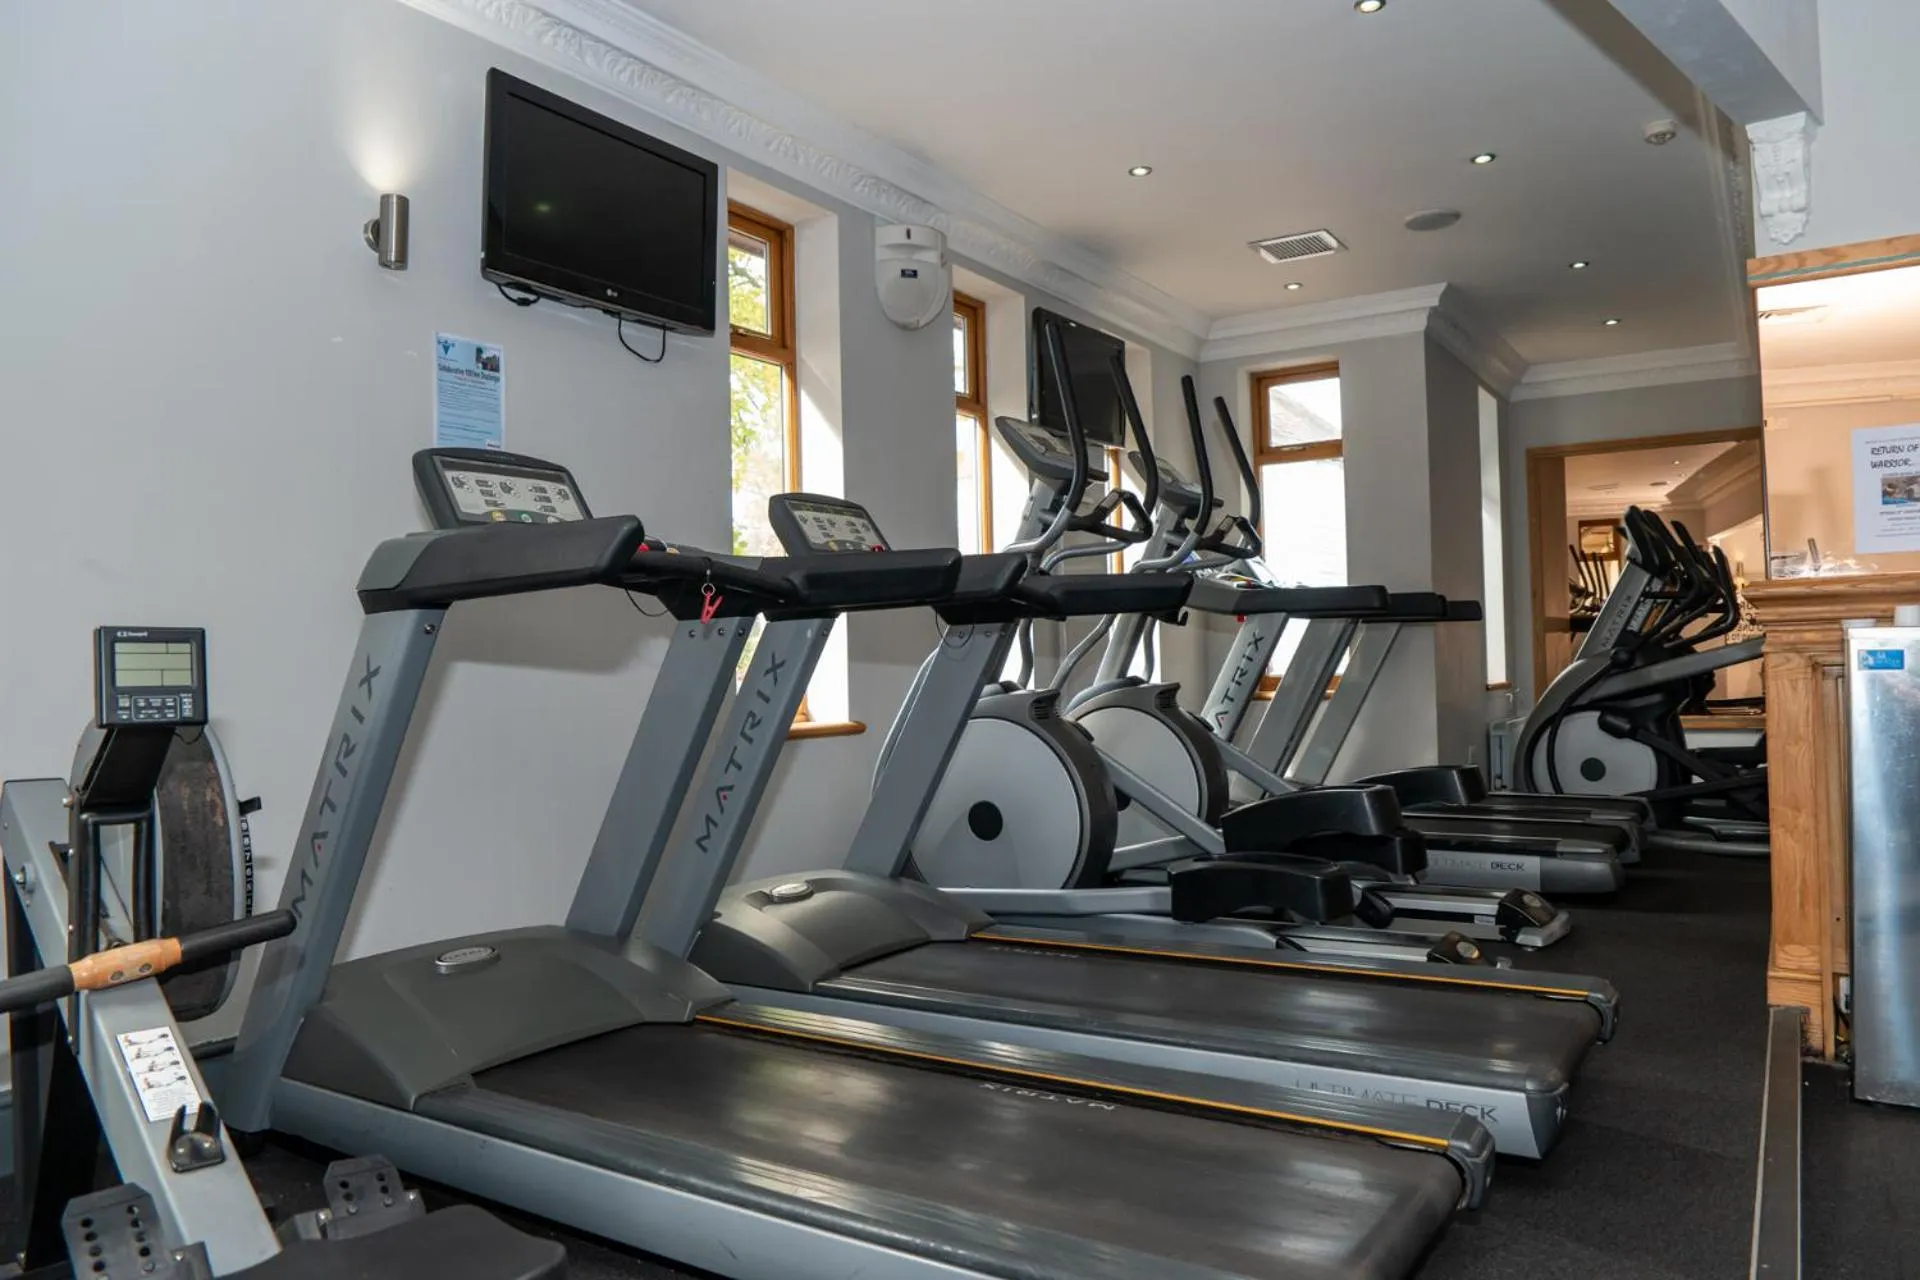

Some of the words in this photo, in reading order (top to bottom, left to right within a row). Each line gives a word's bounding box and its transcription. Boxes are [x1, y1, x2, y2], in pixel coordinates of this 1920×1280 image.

[1870, 445, 1905, 456] RETURN
[1907, 443, 1919, 454] OF
[1215, 632, 1265, 729] ATRIX
[695, 652, 787, 853] MATRIX
[291, 653, 381, 919] MATRIX
[1491, 862, 1525, 872] DECK
[980, 1082, 1116, 1110] MATRIX
[1426, 1099, 1499, 1122] DECK
